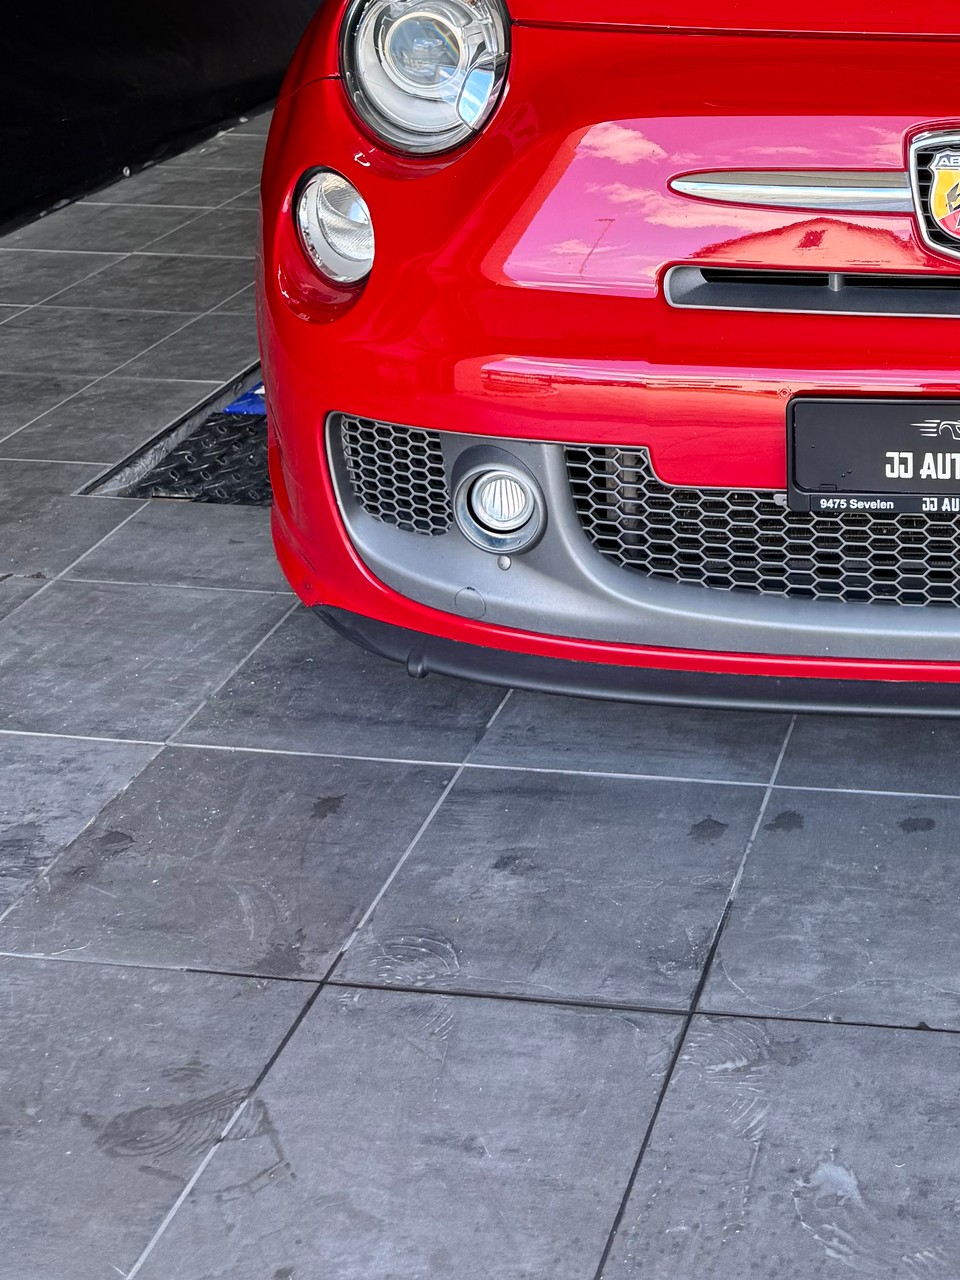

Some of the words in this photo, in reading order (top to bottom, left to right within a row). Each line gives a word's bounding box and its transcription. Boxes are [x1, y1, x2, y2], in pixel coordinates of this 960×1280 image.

[885, 451, 914, 479] JJ
[820, 498, 847, 510] 9475
[849, 498, 895, 510] Sevelen
[922, 497, 938, 512] JJ
